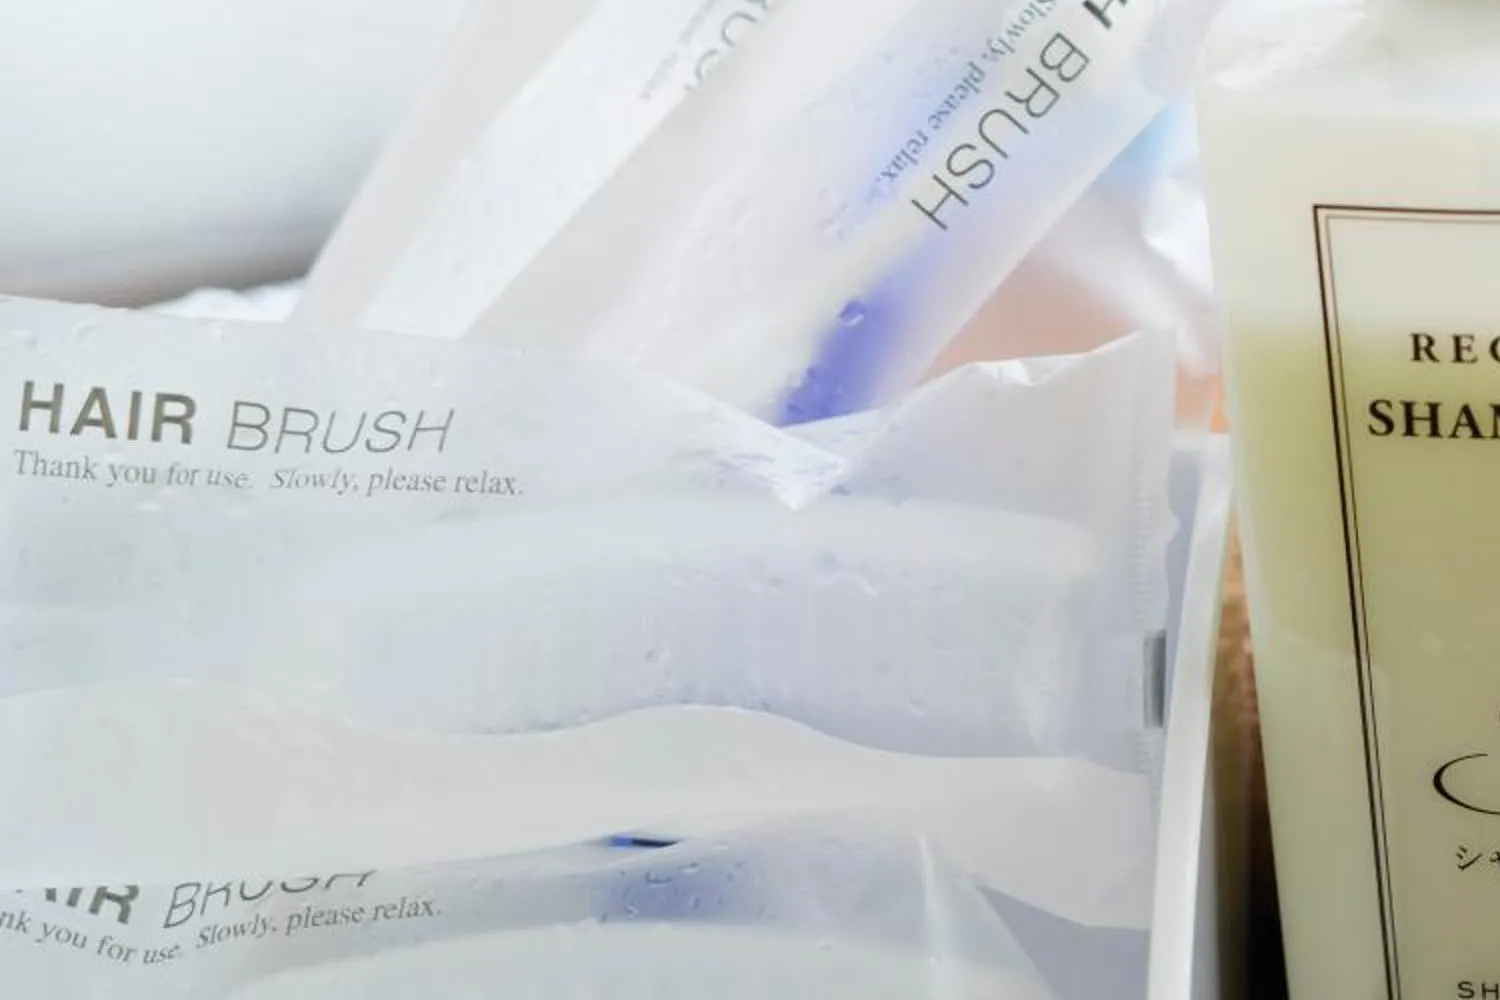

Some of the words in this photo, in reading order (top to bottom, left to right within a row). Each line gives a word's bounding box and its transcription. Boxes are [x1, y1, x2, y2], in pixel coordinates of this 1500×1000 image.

[927, 60, 988, 129] please
[911, 32, 1090, 231] BRUSH
[18, 380, 197, 445] HAIR
[226, 400, 455, 454] BRUSH
[13, 448, 97, 481] Thank
[106, 463, 157, 488] you
[165, 461, 201, 487] for
[206, 470, 254, 489] use.
[366, 465, 447, 497] please
[453, 470, 525, 497] relax.
[35, 921, 88, 950] you
[97, 935, 138, 964] for
[285, 904, 367, 937] please
[372, 895, 442, 921] relax.
